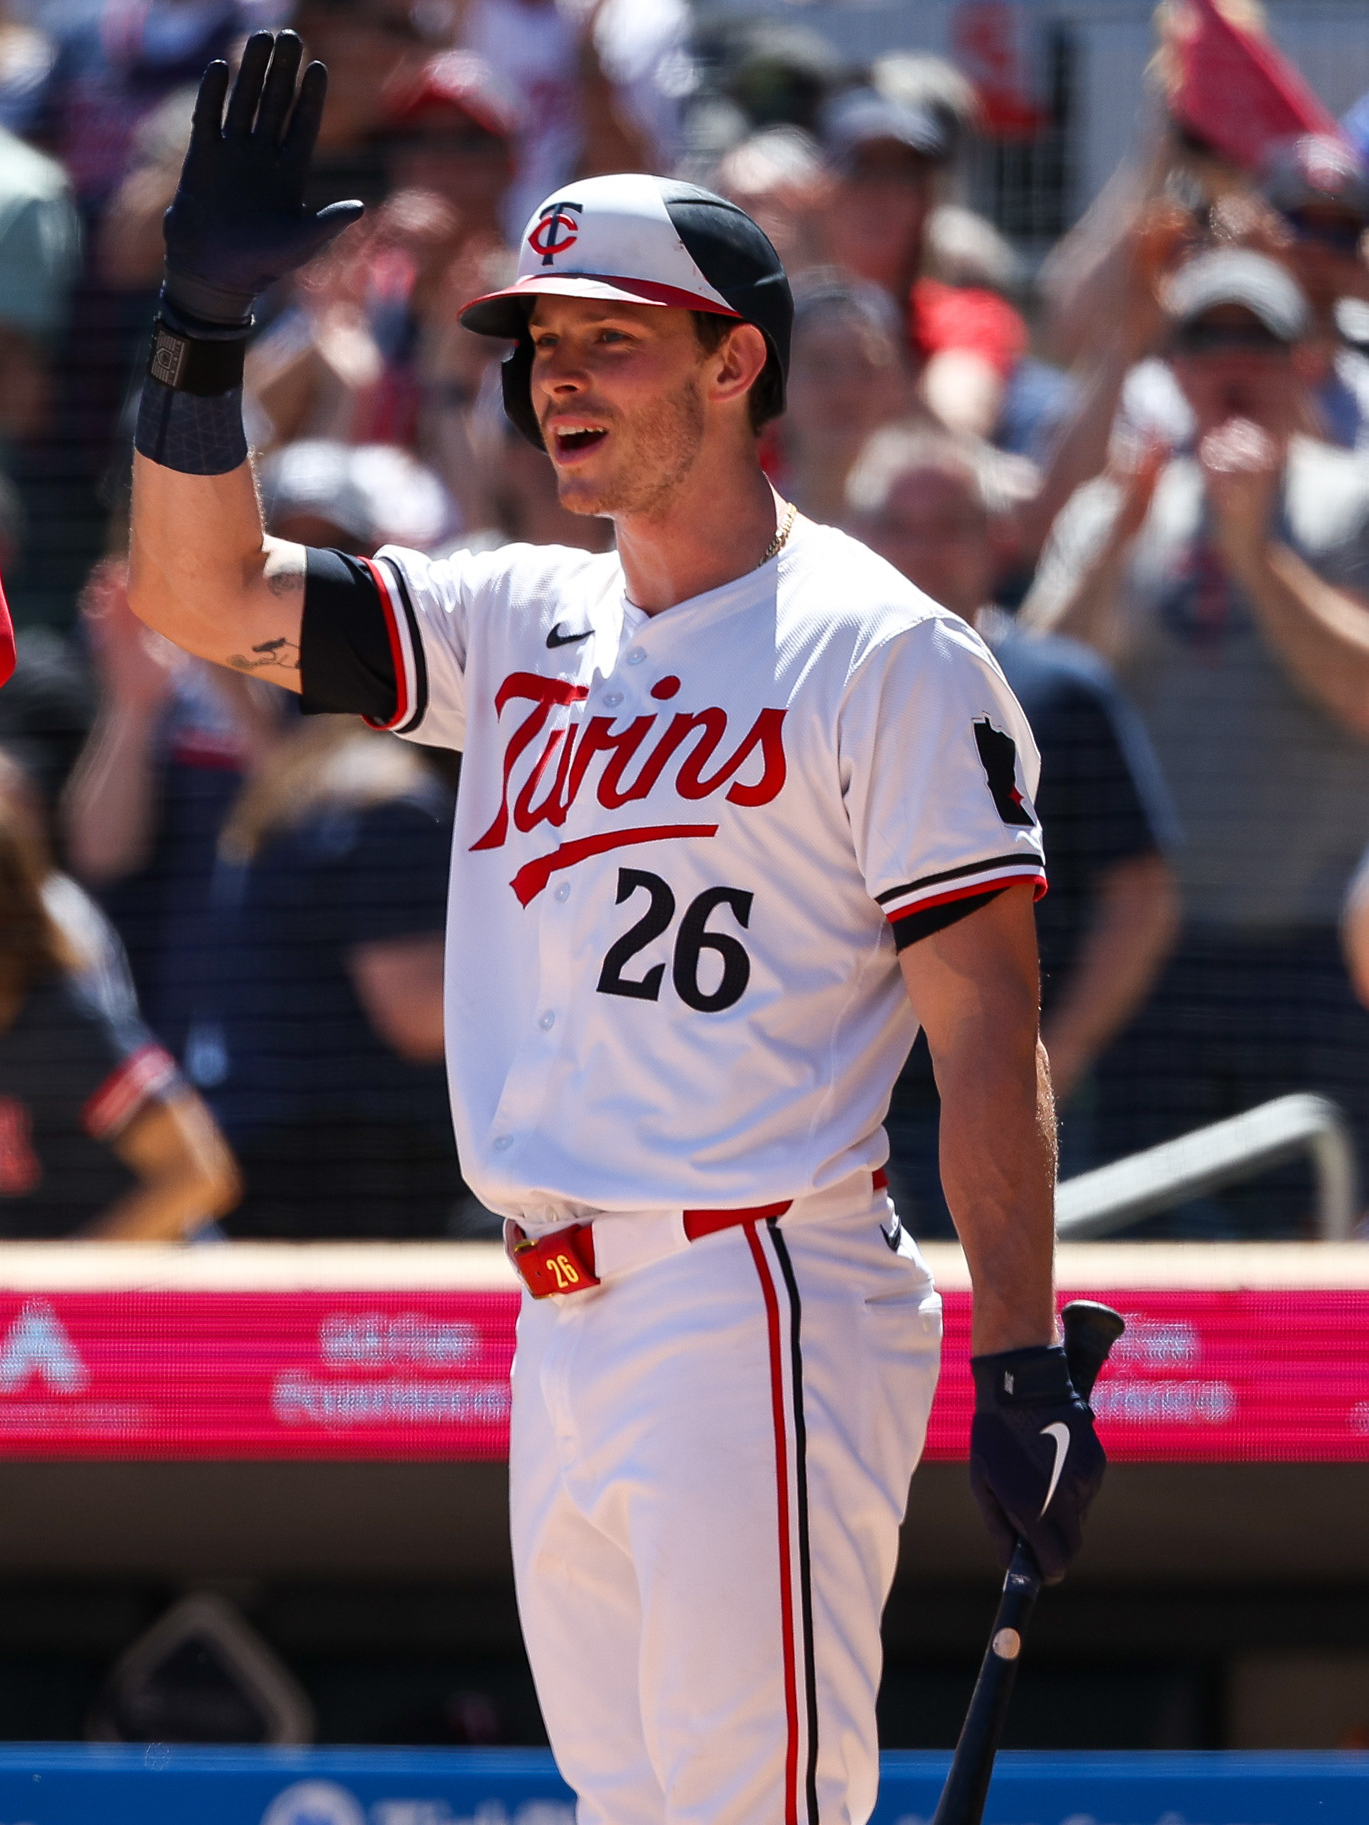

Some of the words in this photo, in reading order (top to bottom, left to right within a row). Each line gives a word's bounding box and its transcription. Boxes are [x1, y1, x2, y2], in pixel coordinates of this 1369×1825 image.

[469, 671, 787, 851] Twins
[596, 867, 755, 1013] 26
[546, 1254, 580, 1289] 26
